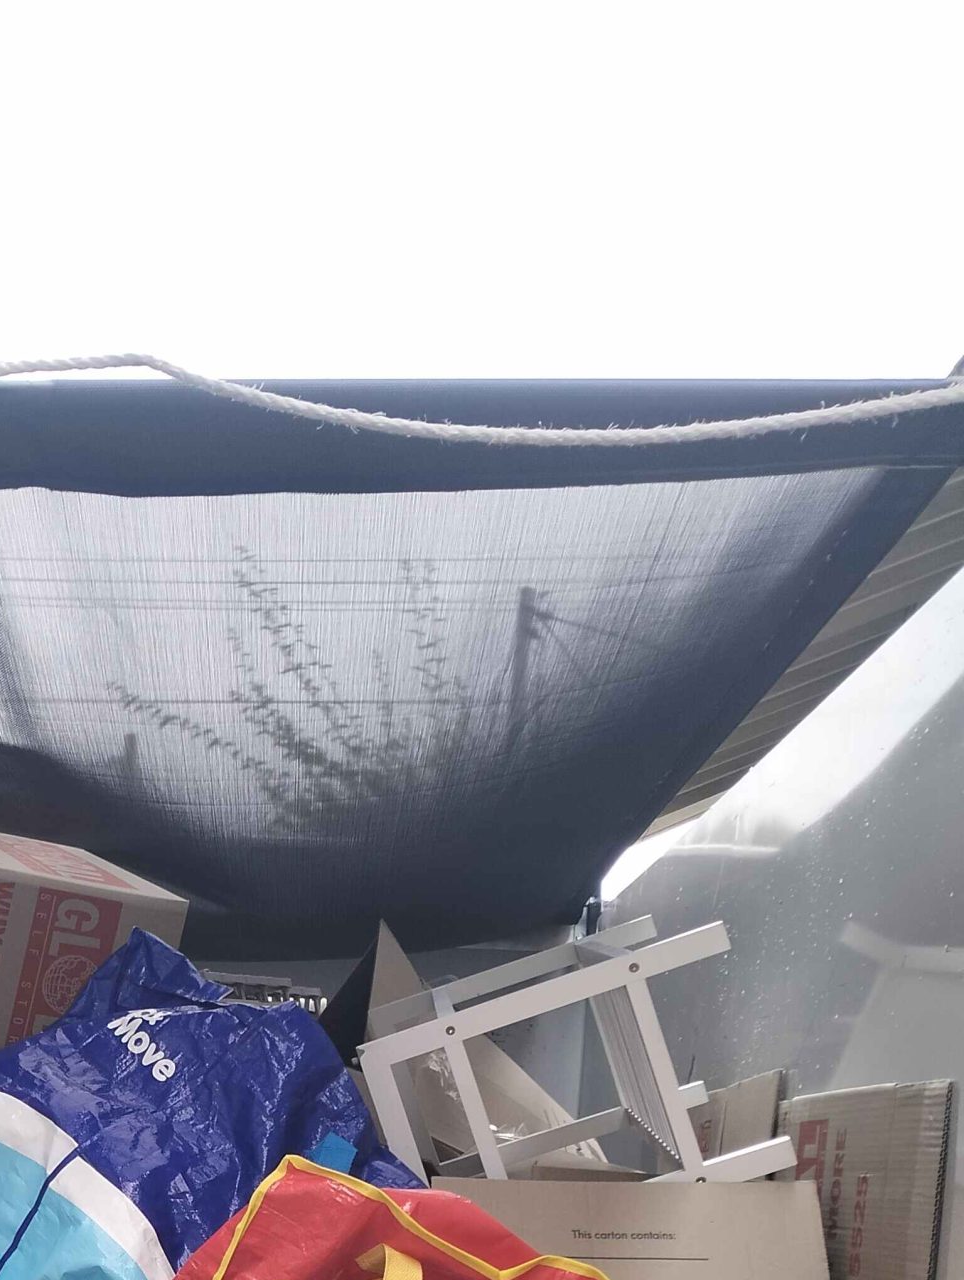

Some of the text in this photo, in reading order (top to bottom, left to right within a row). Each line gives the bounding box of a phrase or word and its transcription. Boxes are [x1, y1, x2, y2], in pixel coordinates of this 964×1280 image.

[8, 892, 52, 1044] SELF STOR
[107, 1014, 176, 1082] Move
[571, 1229, 677, 1240] This carton contains:
